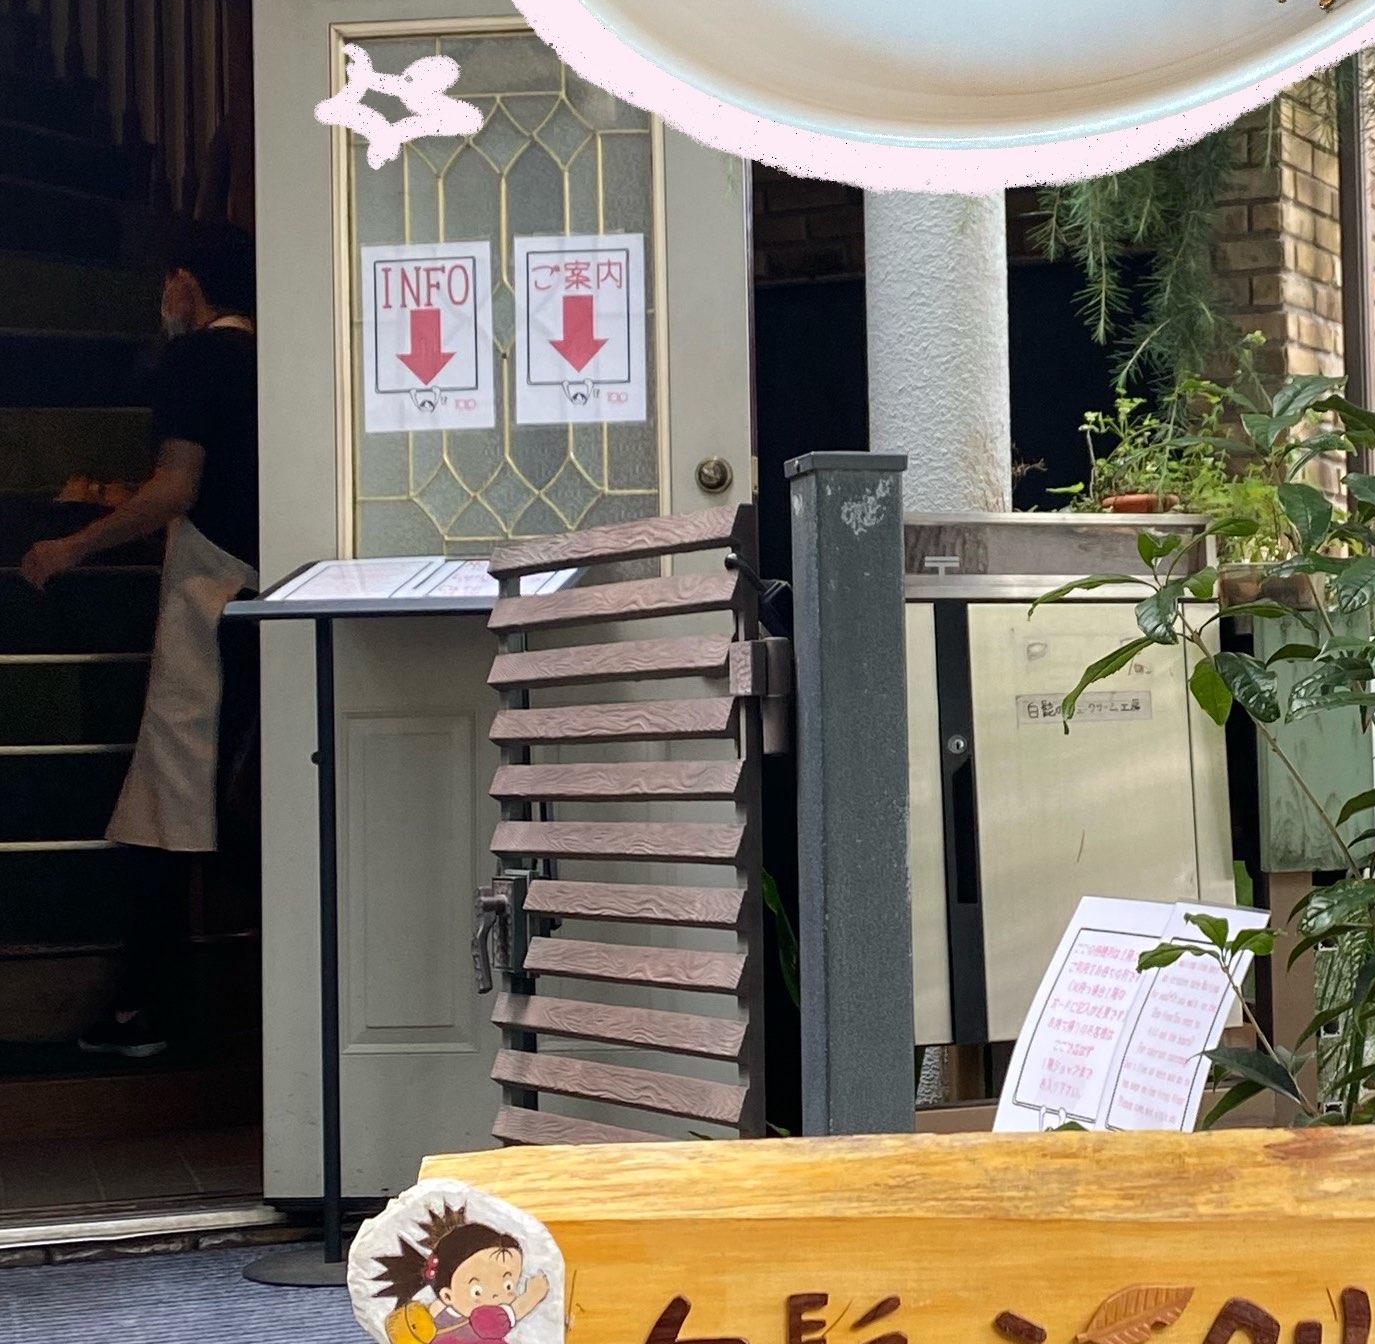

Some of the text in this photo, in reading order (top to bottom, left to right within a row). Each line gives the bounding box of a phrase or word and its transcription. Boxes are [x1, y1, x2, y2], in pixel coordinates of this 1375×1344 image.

[381, 264, 470, 309] INFO
[531, 259, 624, 291] ご案内
[1027, 697, 1142, 719] 白髭のュークリーム工房
